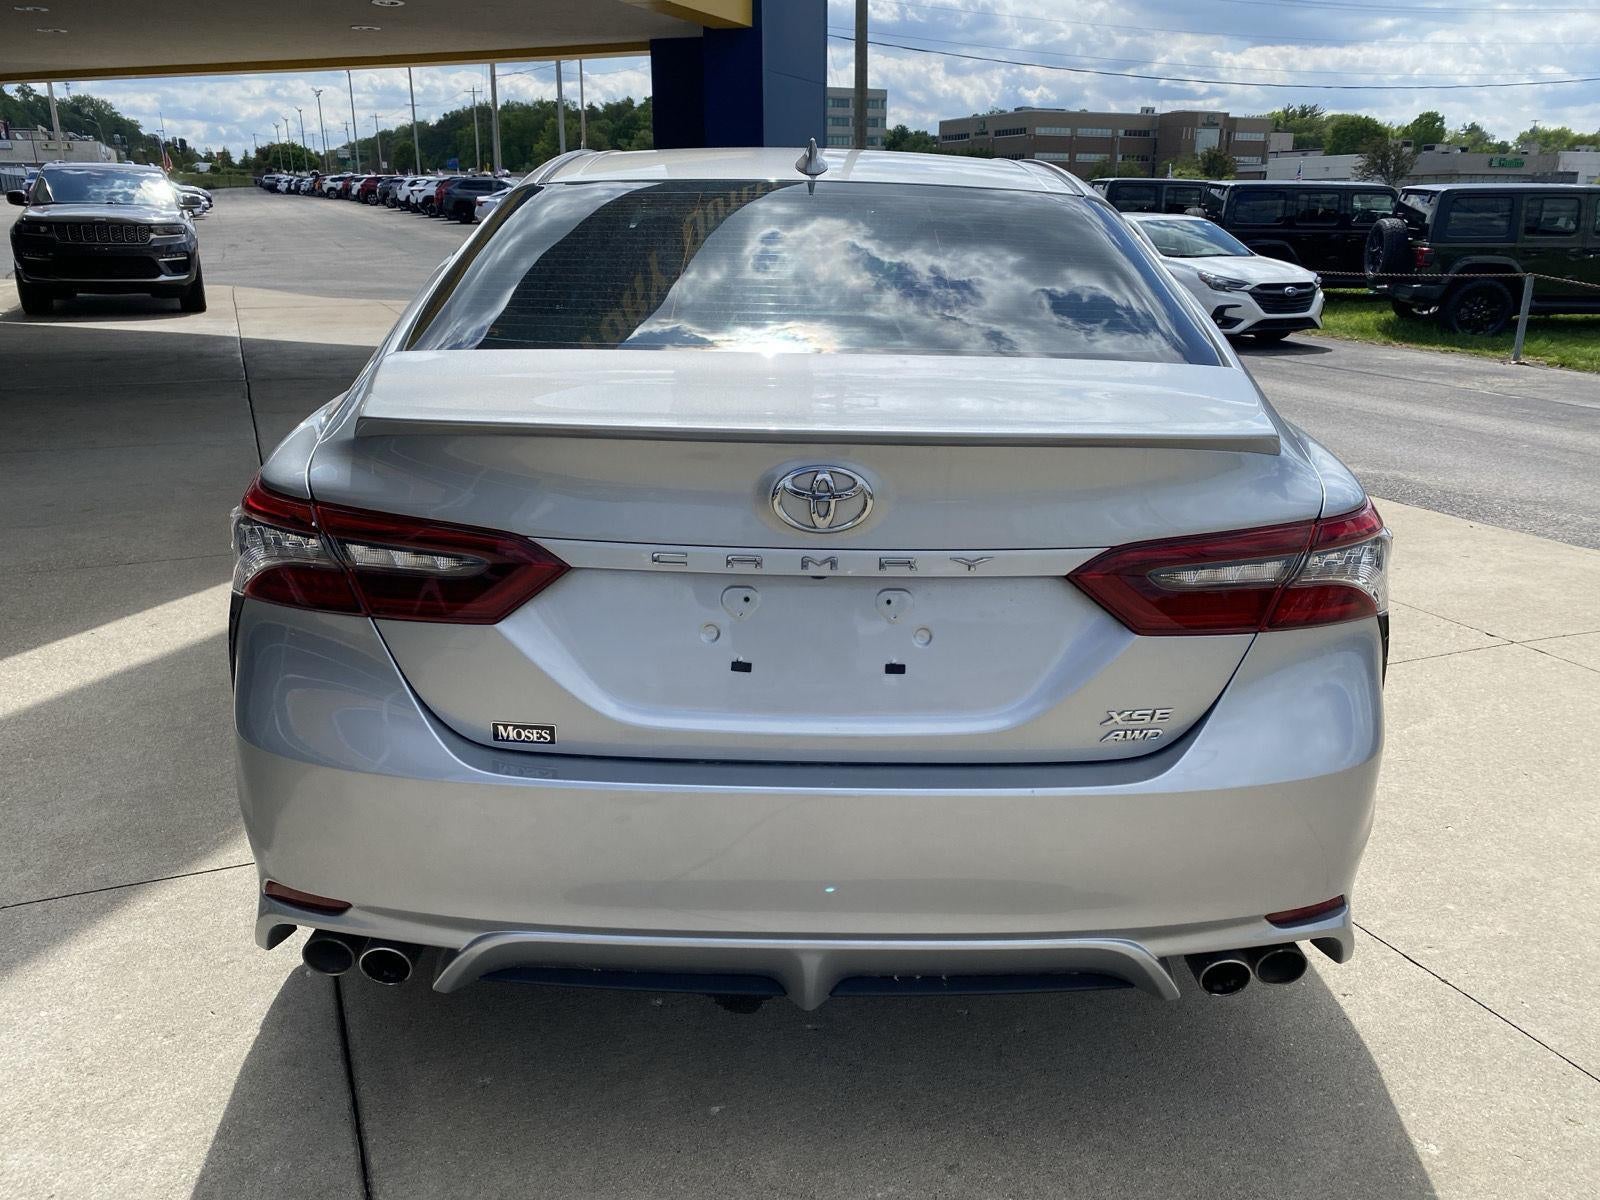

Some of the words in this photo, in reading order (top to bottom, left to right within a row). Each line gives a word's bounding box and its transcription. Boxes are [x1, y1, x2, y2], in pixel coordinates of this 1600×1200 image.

[651, 551, 995, 571] CAMRY
[1100, 708, 1174, 725] XSE
[497, 725, 550, 742] MOSES
[1100, 728, 1163, 742] AWD
